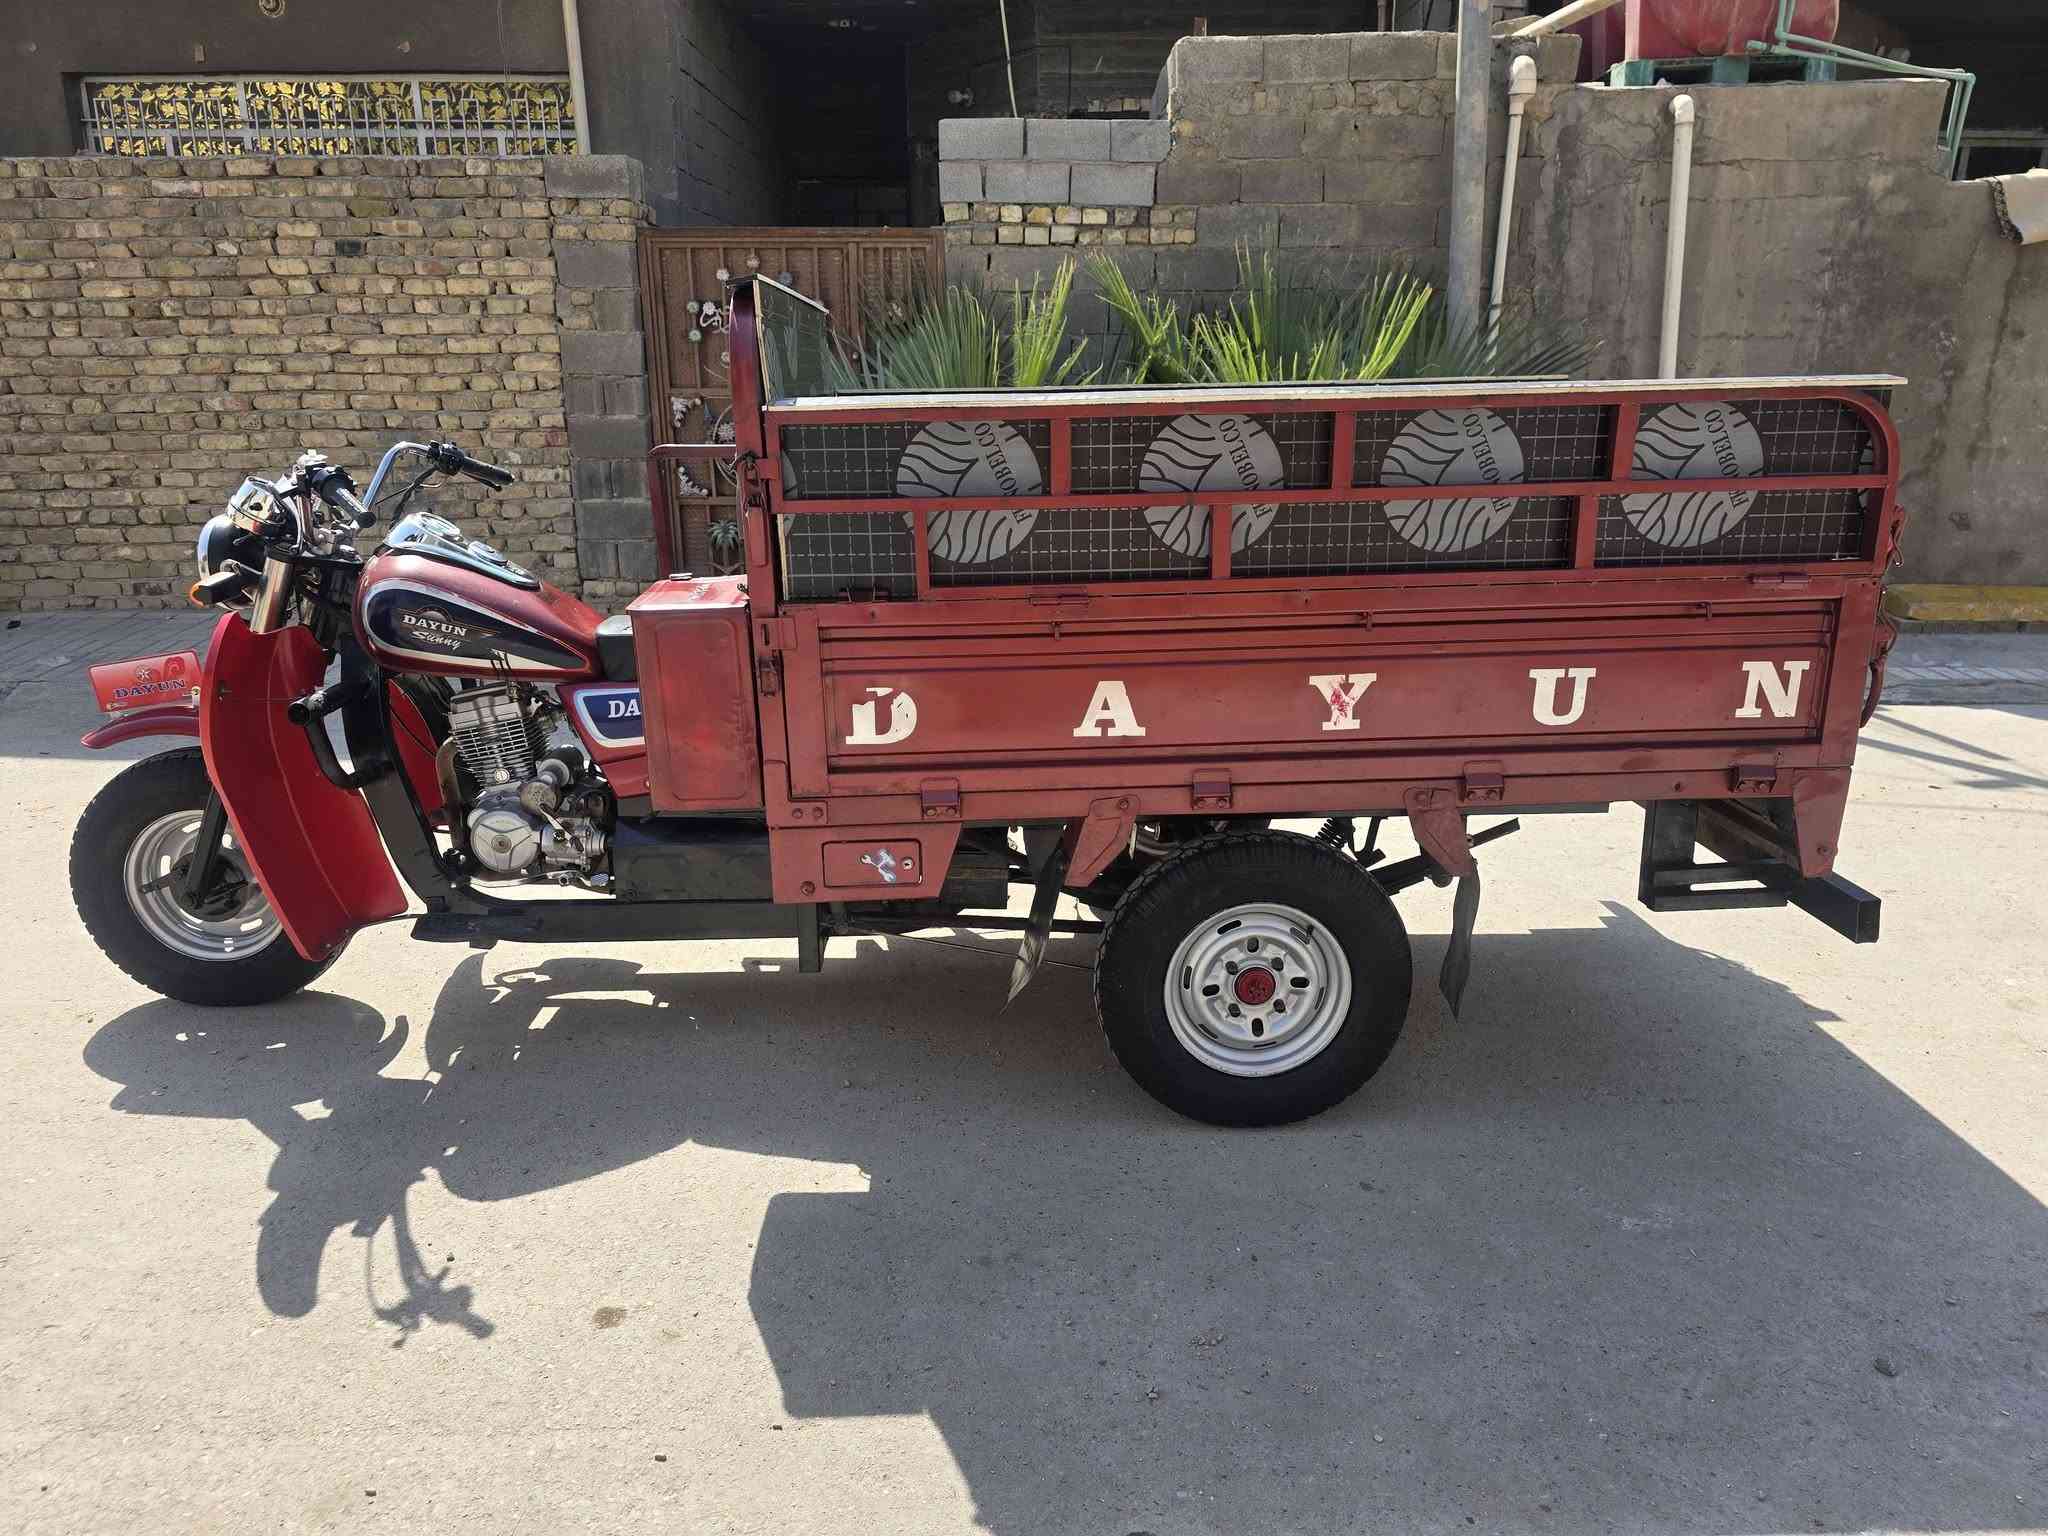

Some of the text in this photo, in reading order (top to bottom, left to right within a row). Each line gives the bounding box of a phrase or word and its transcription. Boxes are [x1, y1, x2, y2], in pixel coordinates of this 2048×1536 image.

[402, 614, 467, 636] DAYUN
[411, 631, 462, 651] Sunny
[114, 679, 185, 698] DAYUN
